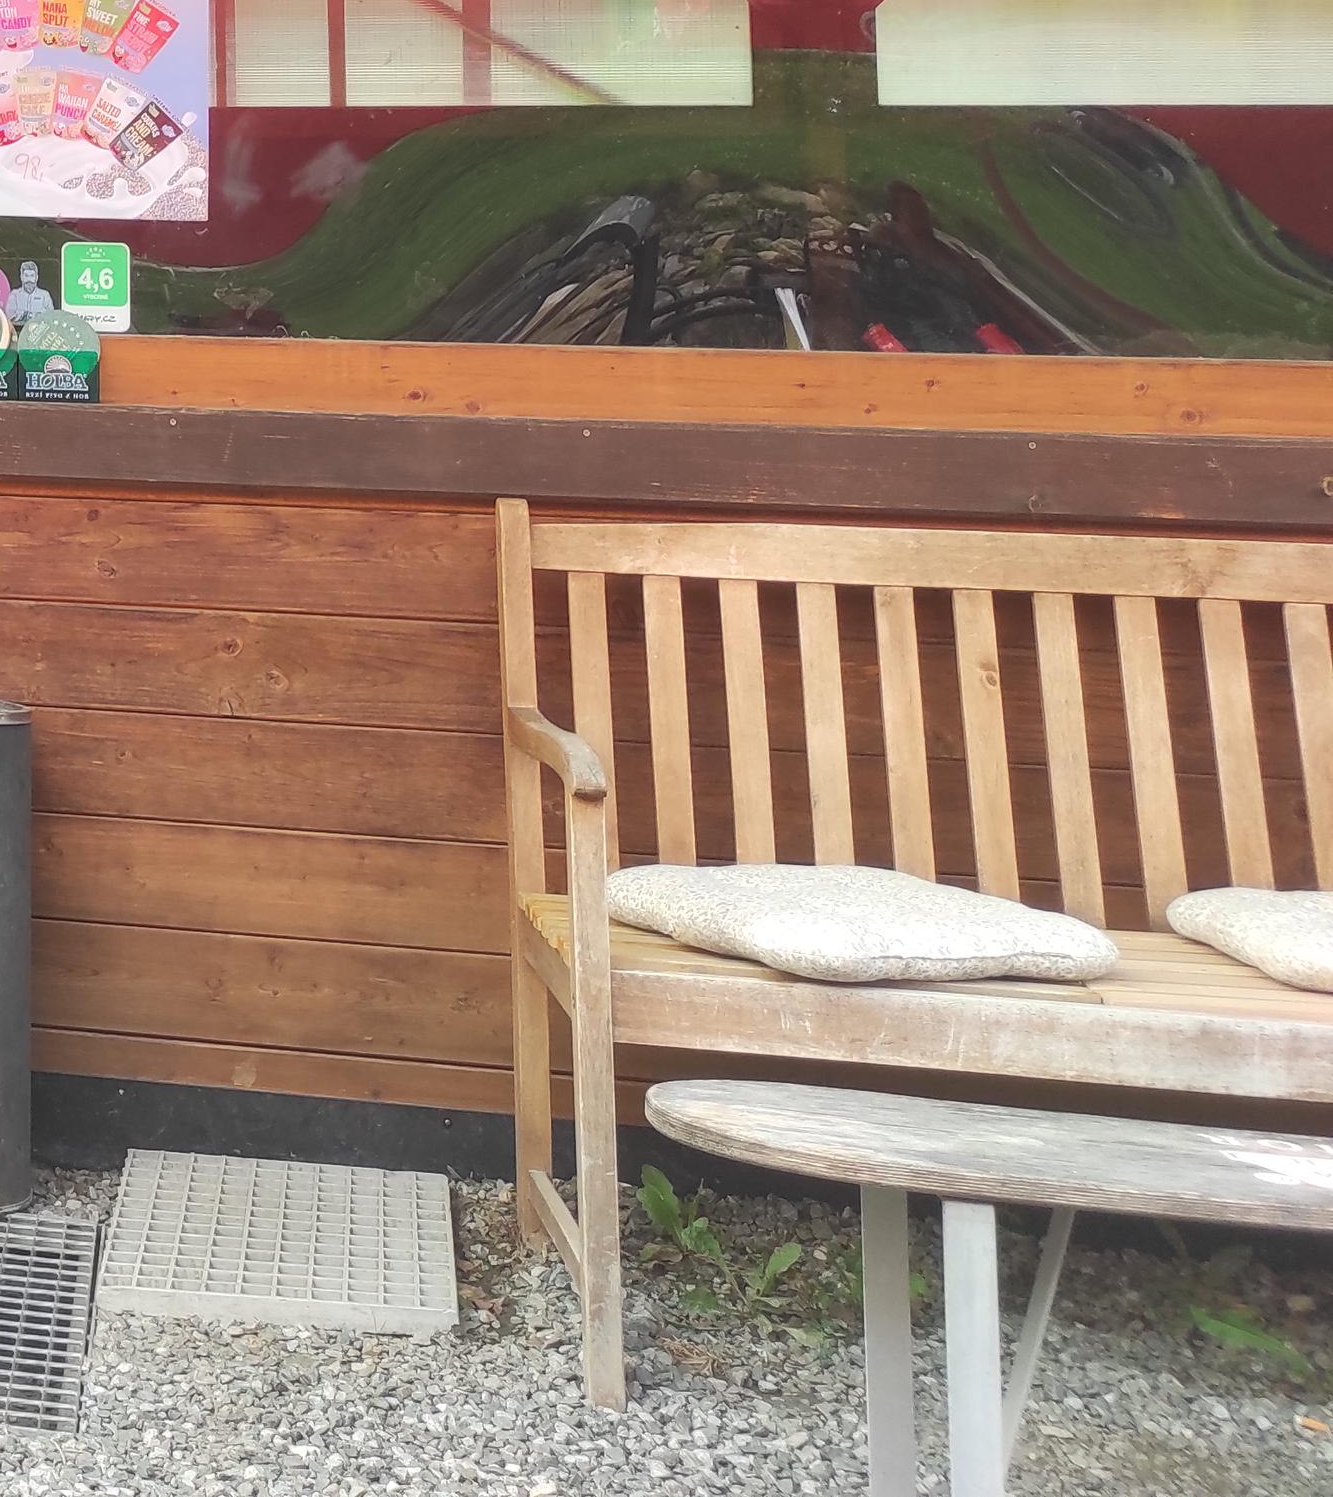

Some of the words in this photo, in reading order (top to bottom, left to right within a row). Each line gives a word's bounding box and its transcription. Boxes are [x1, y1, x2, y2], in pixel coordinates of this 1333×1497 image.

[42, 1, 68, 14] NANA
[86, 5, 119, 26] SWEET
[1, 16, 33, 31] CANDY
[42, 12, 69, 27] SPLIT
[55, 103, 86, 121] PUNCH
[78, 267, 114, 293] 4,6
[25, 371, 89, 392] HOLBA
